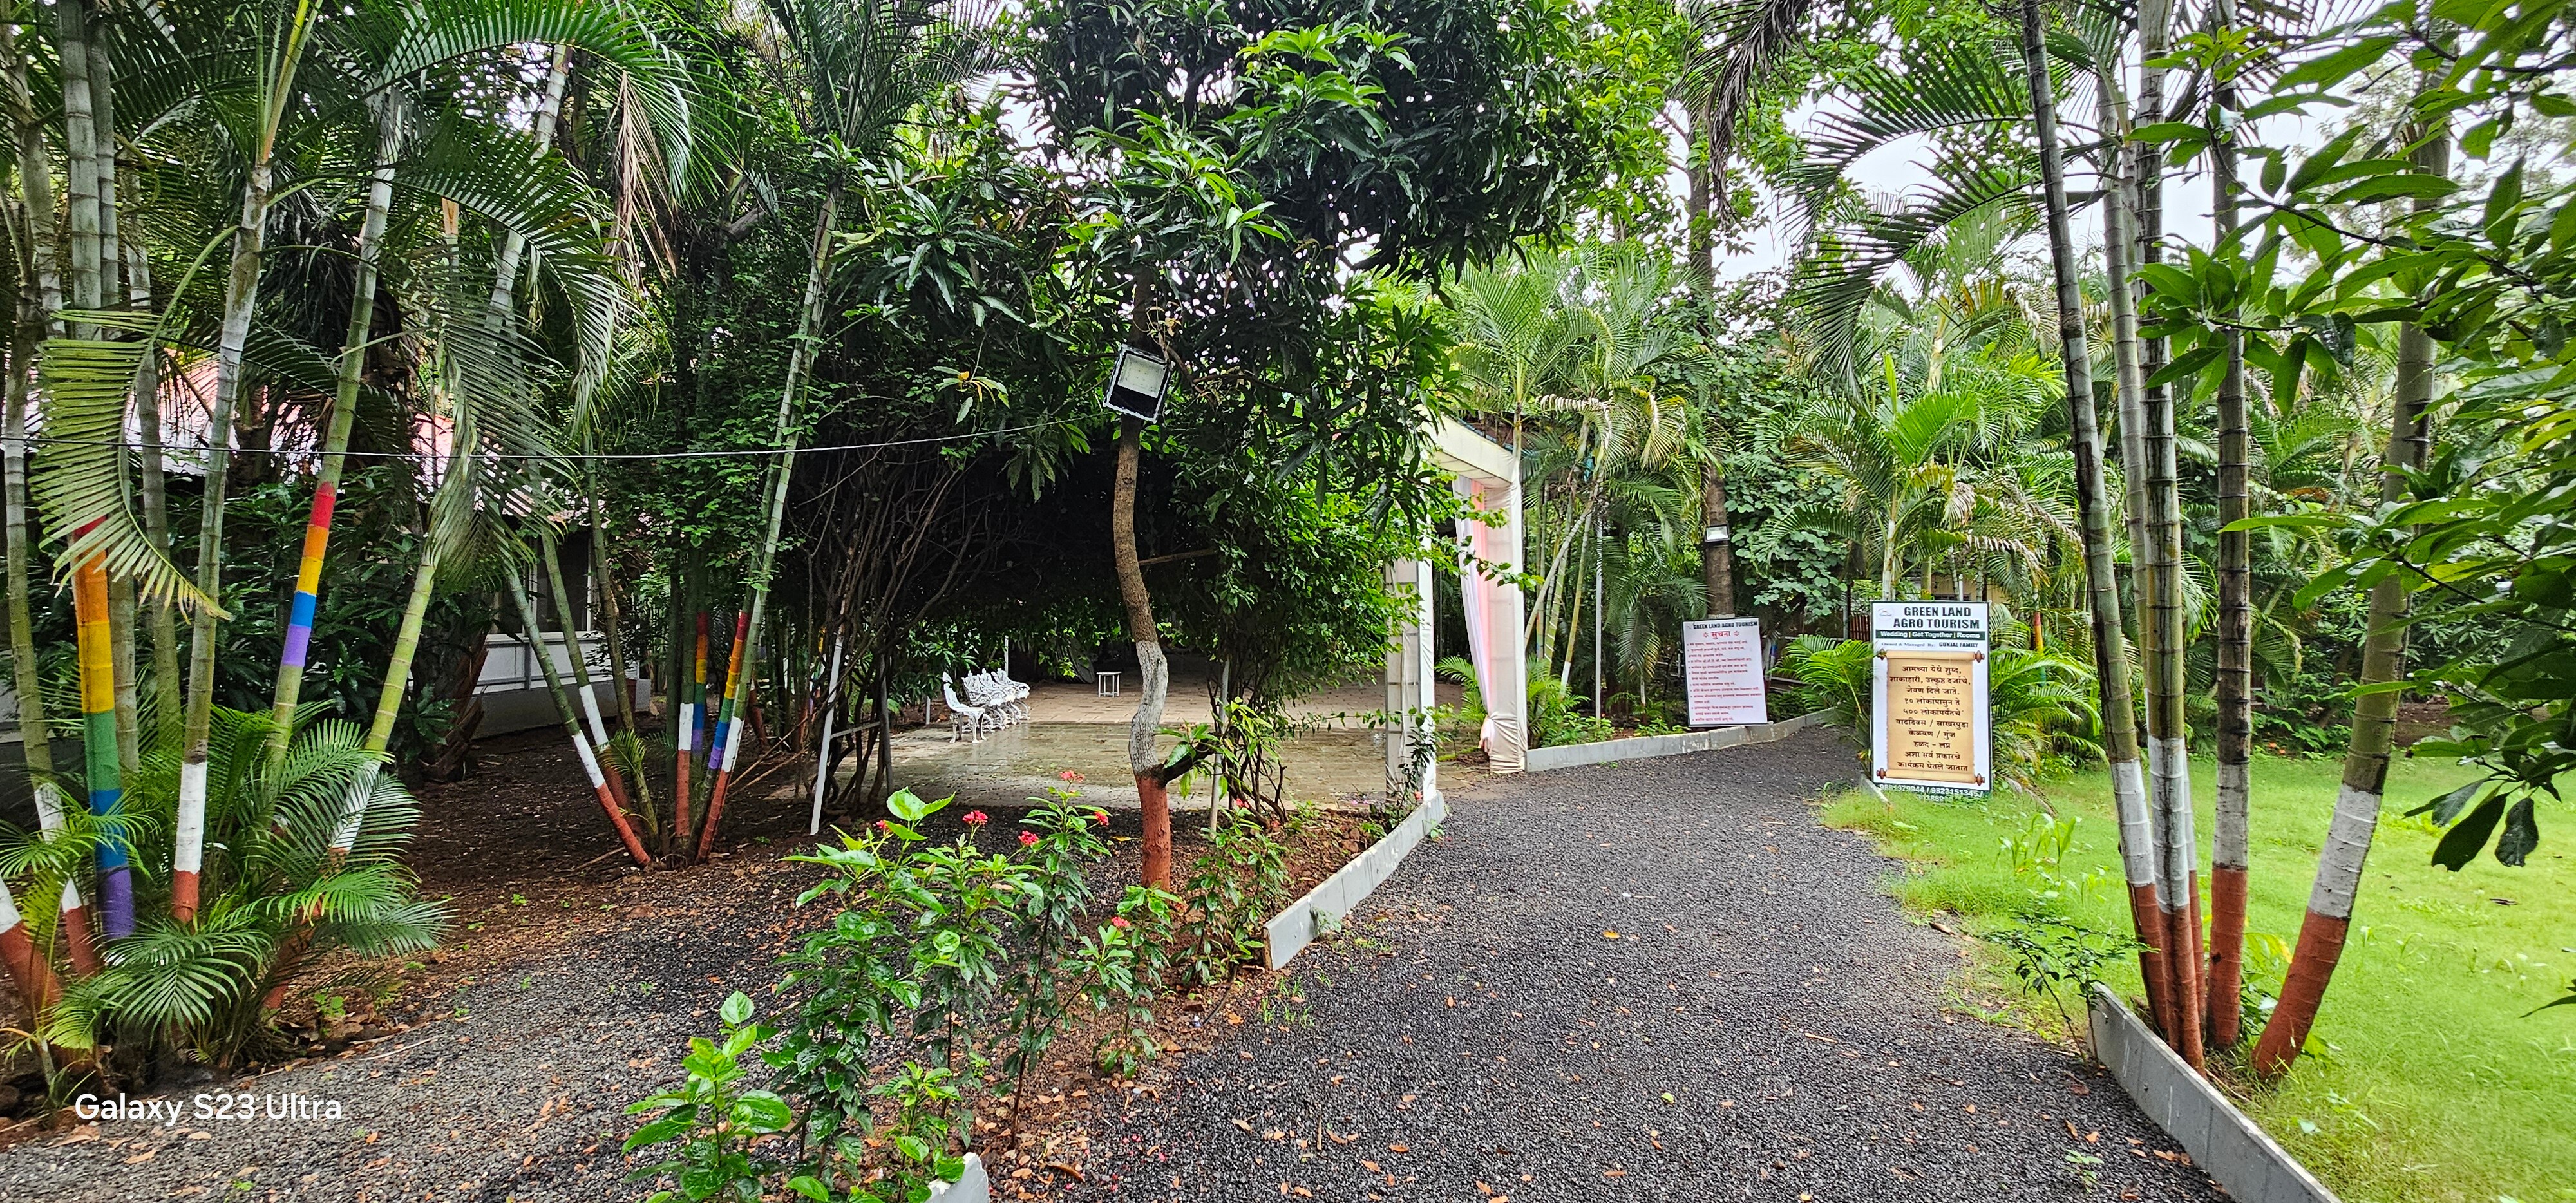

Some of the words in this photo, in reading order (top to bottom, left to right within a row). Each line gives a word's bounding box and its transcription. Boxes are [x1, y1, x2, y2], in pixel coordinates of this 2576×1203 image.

[1904, 607, 1939, 616] GREEN
[1942, 607, 1971, 616] LAND
[1893, 618, 1924, 628] AGRO
[1926, 618, 1980, 629] TOURISM
[1710, 630, 1731, 639] सुचना
[1906, 685, 1924, 694] जेवण
[1942, 687, 1960, 695] जाते.
[1895, 717, 1926, 726] वाढदिवस
[1936, 721, 1969, 730] साखरपुडा
[1908, 728, 1933, 737] केळवण
[1943, 730, 1956, 740] मुंज
[1897, 760, 1924, 768] कार्यक्रम
